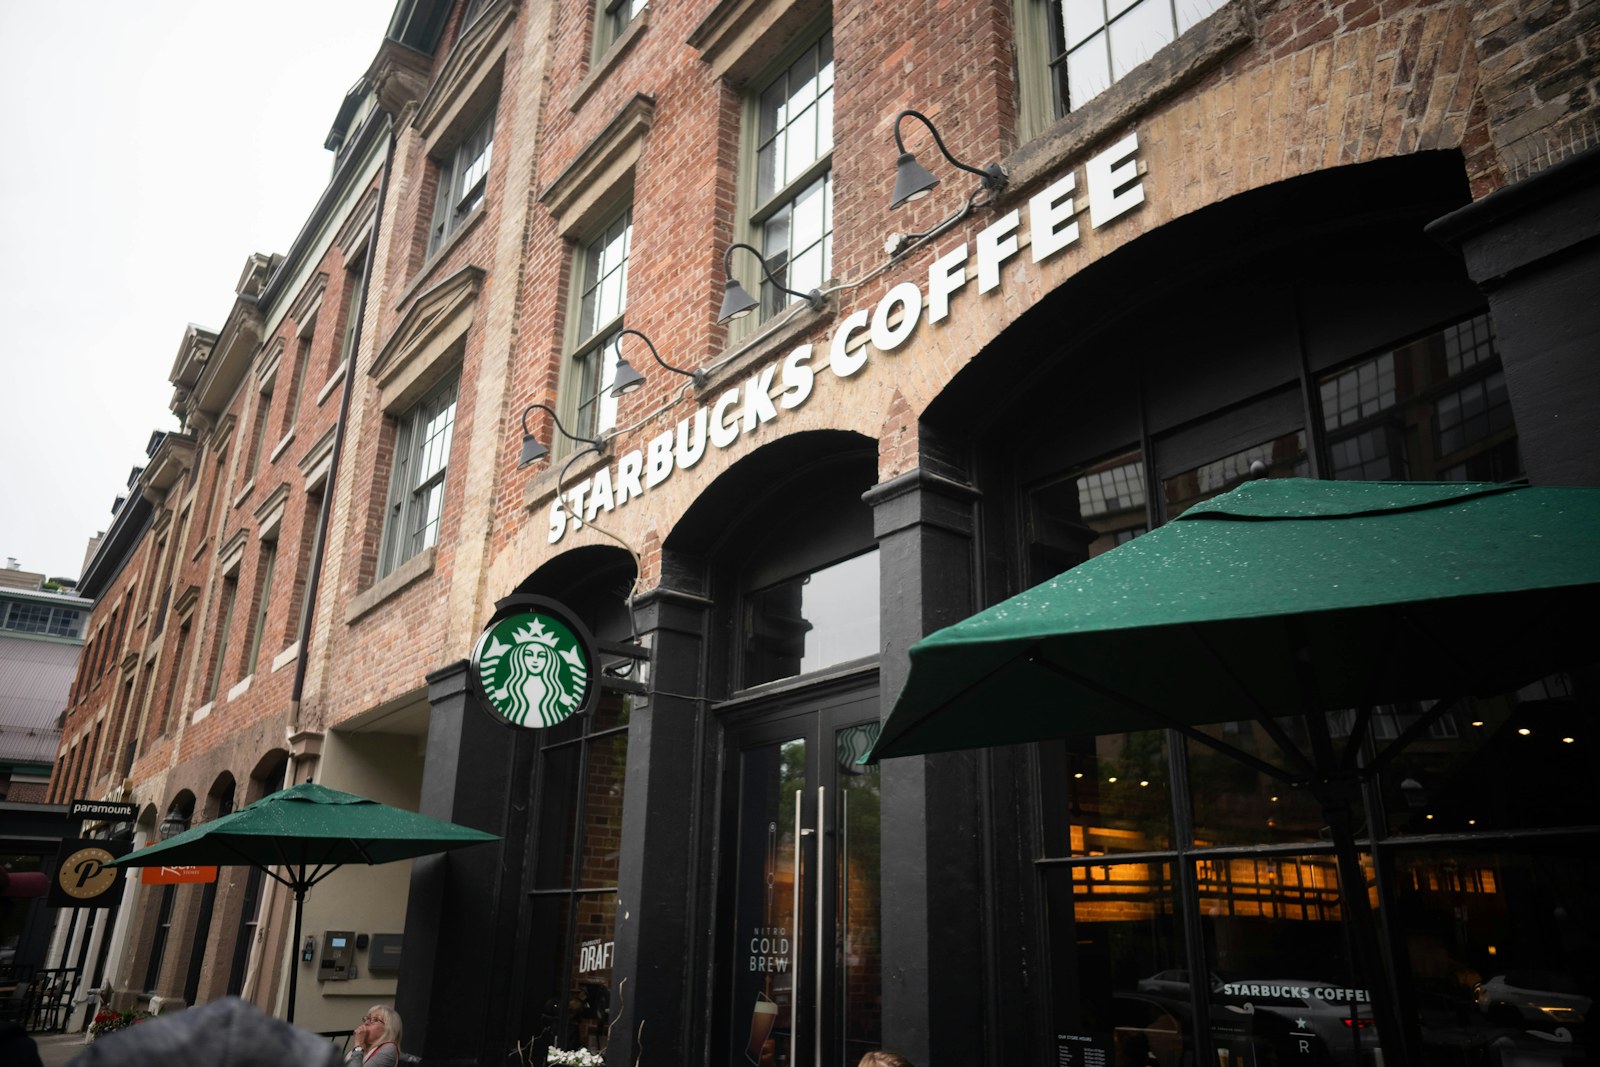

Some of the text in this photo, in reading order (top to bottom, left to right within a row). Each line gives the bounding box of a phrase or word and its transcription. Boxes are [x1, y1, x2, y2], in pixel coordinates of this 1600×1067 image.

[547, 131, 1146, 545] STARBUCKS COFFEE
[73, 803, 132, 815] paramount
[753, 927, 786, 936] NITRO
[750, 937, 789, 954] COLD
[749, 955, 789, 973] BREW
[1223, 983, 1311, 999] STARBUCKS
